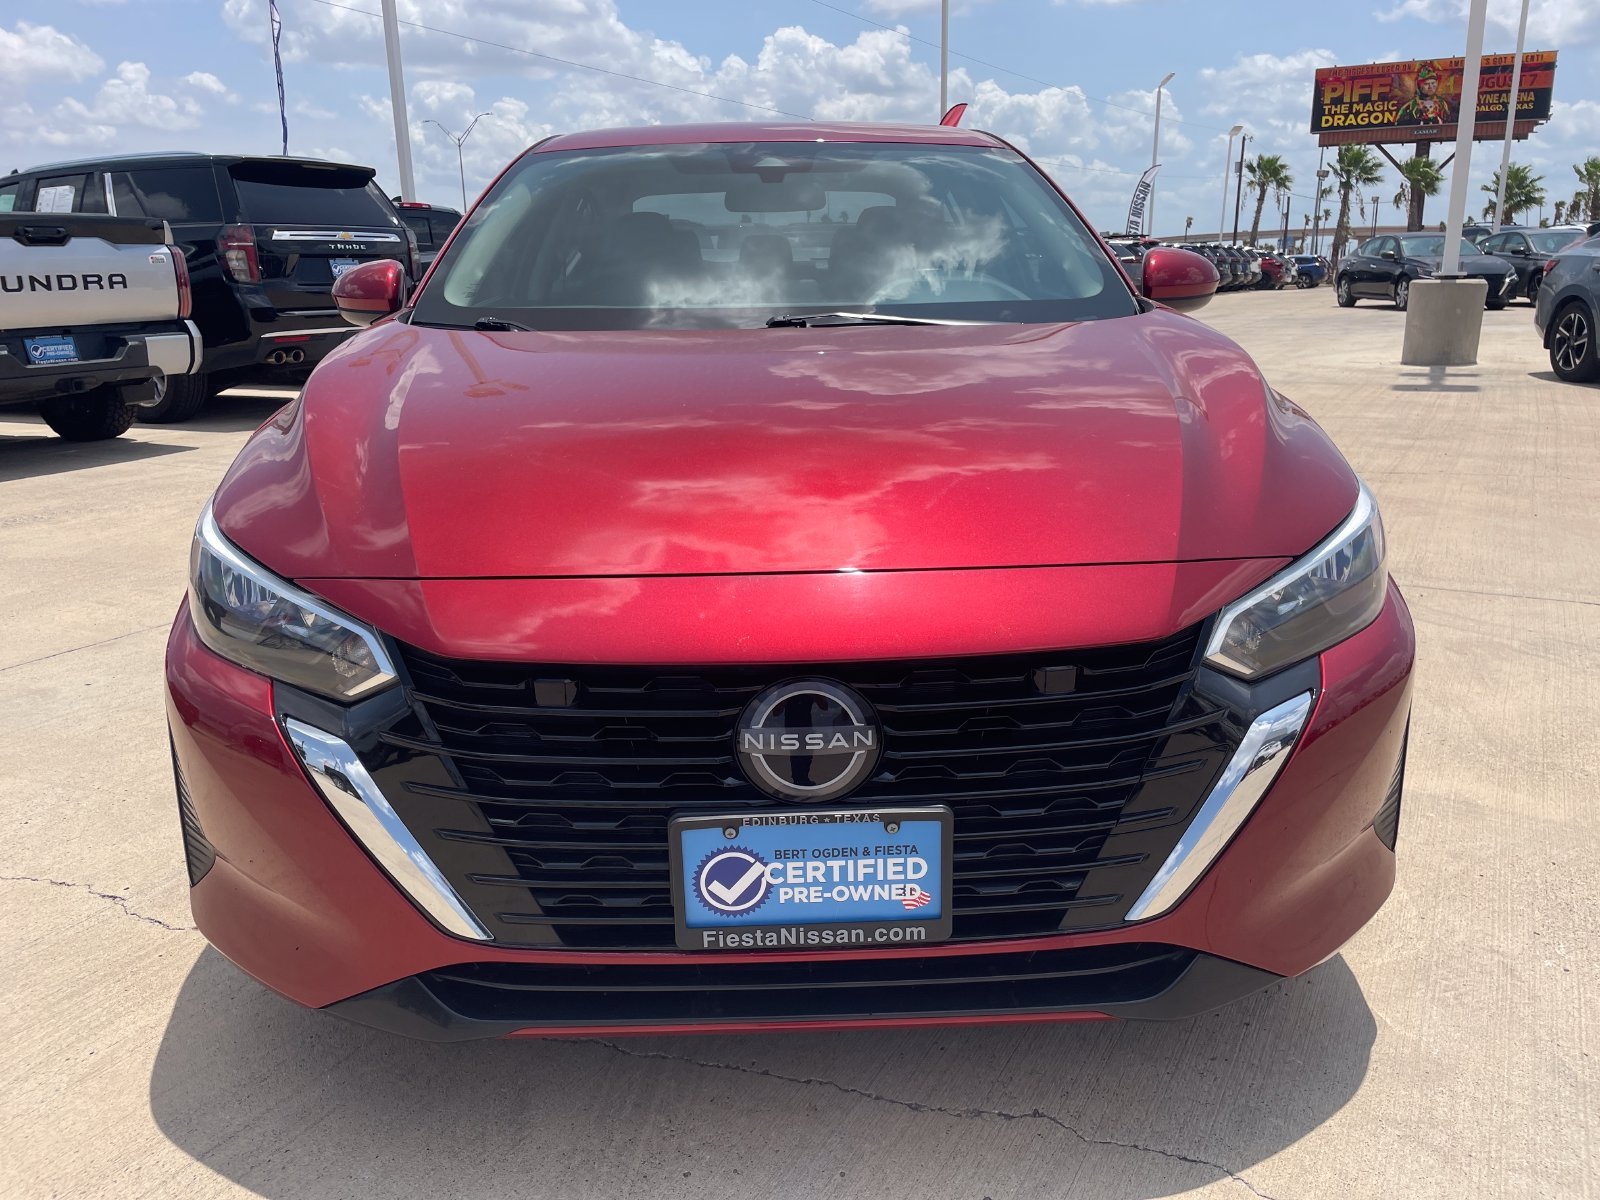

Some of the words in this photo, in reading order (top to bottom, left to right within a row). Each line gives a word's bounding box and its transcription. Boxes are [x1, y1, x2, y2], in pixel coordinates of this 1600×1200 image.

[1492, 56, 1507, 65] GOT
[1323, 77, 1392, 104] PIFF
[1478, 74, 1526, 89] UGUST
[1530, 73, 1538, 86] 7
[1323, 104, 1349, 115] THE
[1352, 101, 1398, 113] MAGIC
[1321, 111, 1396, 128] DRAGON
[1131, 181, 1151, 218] NISSAN
[0, 273, 128, 293] UNDRA
[744, 730, 873, 750] NISSAN
[742, 815, 819, 827] EDINBURG
[834, 813, 880, 824] TEXAS
[774, 848, 808, 860] BERT
[811, 846, 858, 859] OGDEN
[862, 846, 871, 857] &
[875, 844, 919, 856] FIESTA
[764, 856, 928, 885] CERTIFIED
[779, 883, 921, 904] PRE-OWNED
[702, 926, 926, 948] FiestaNissan.com
